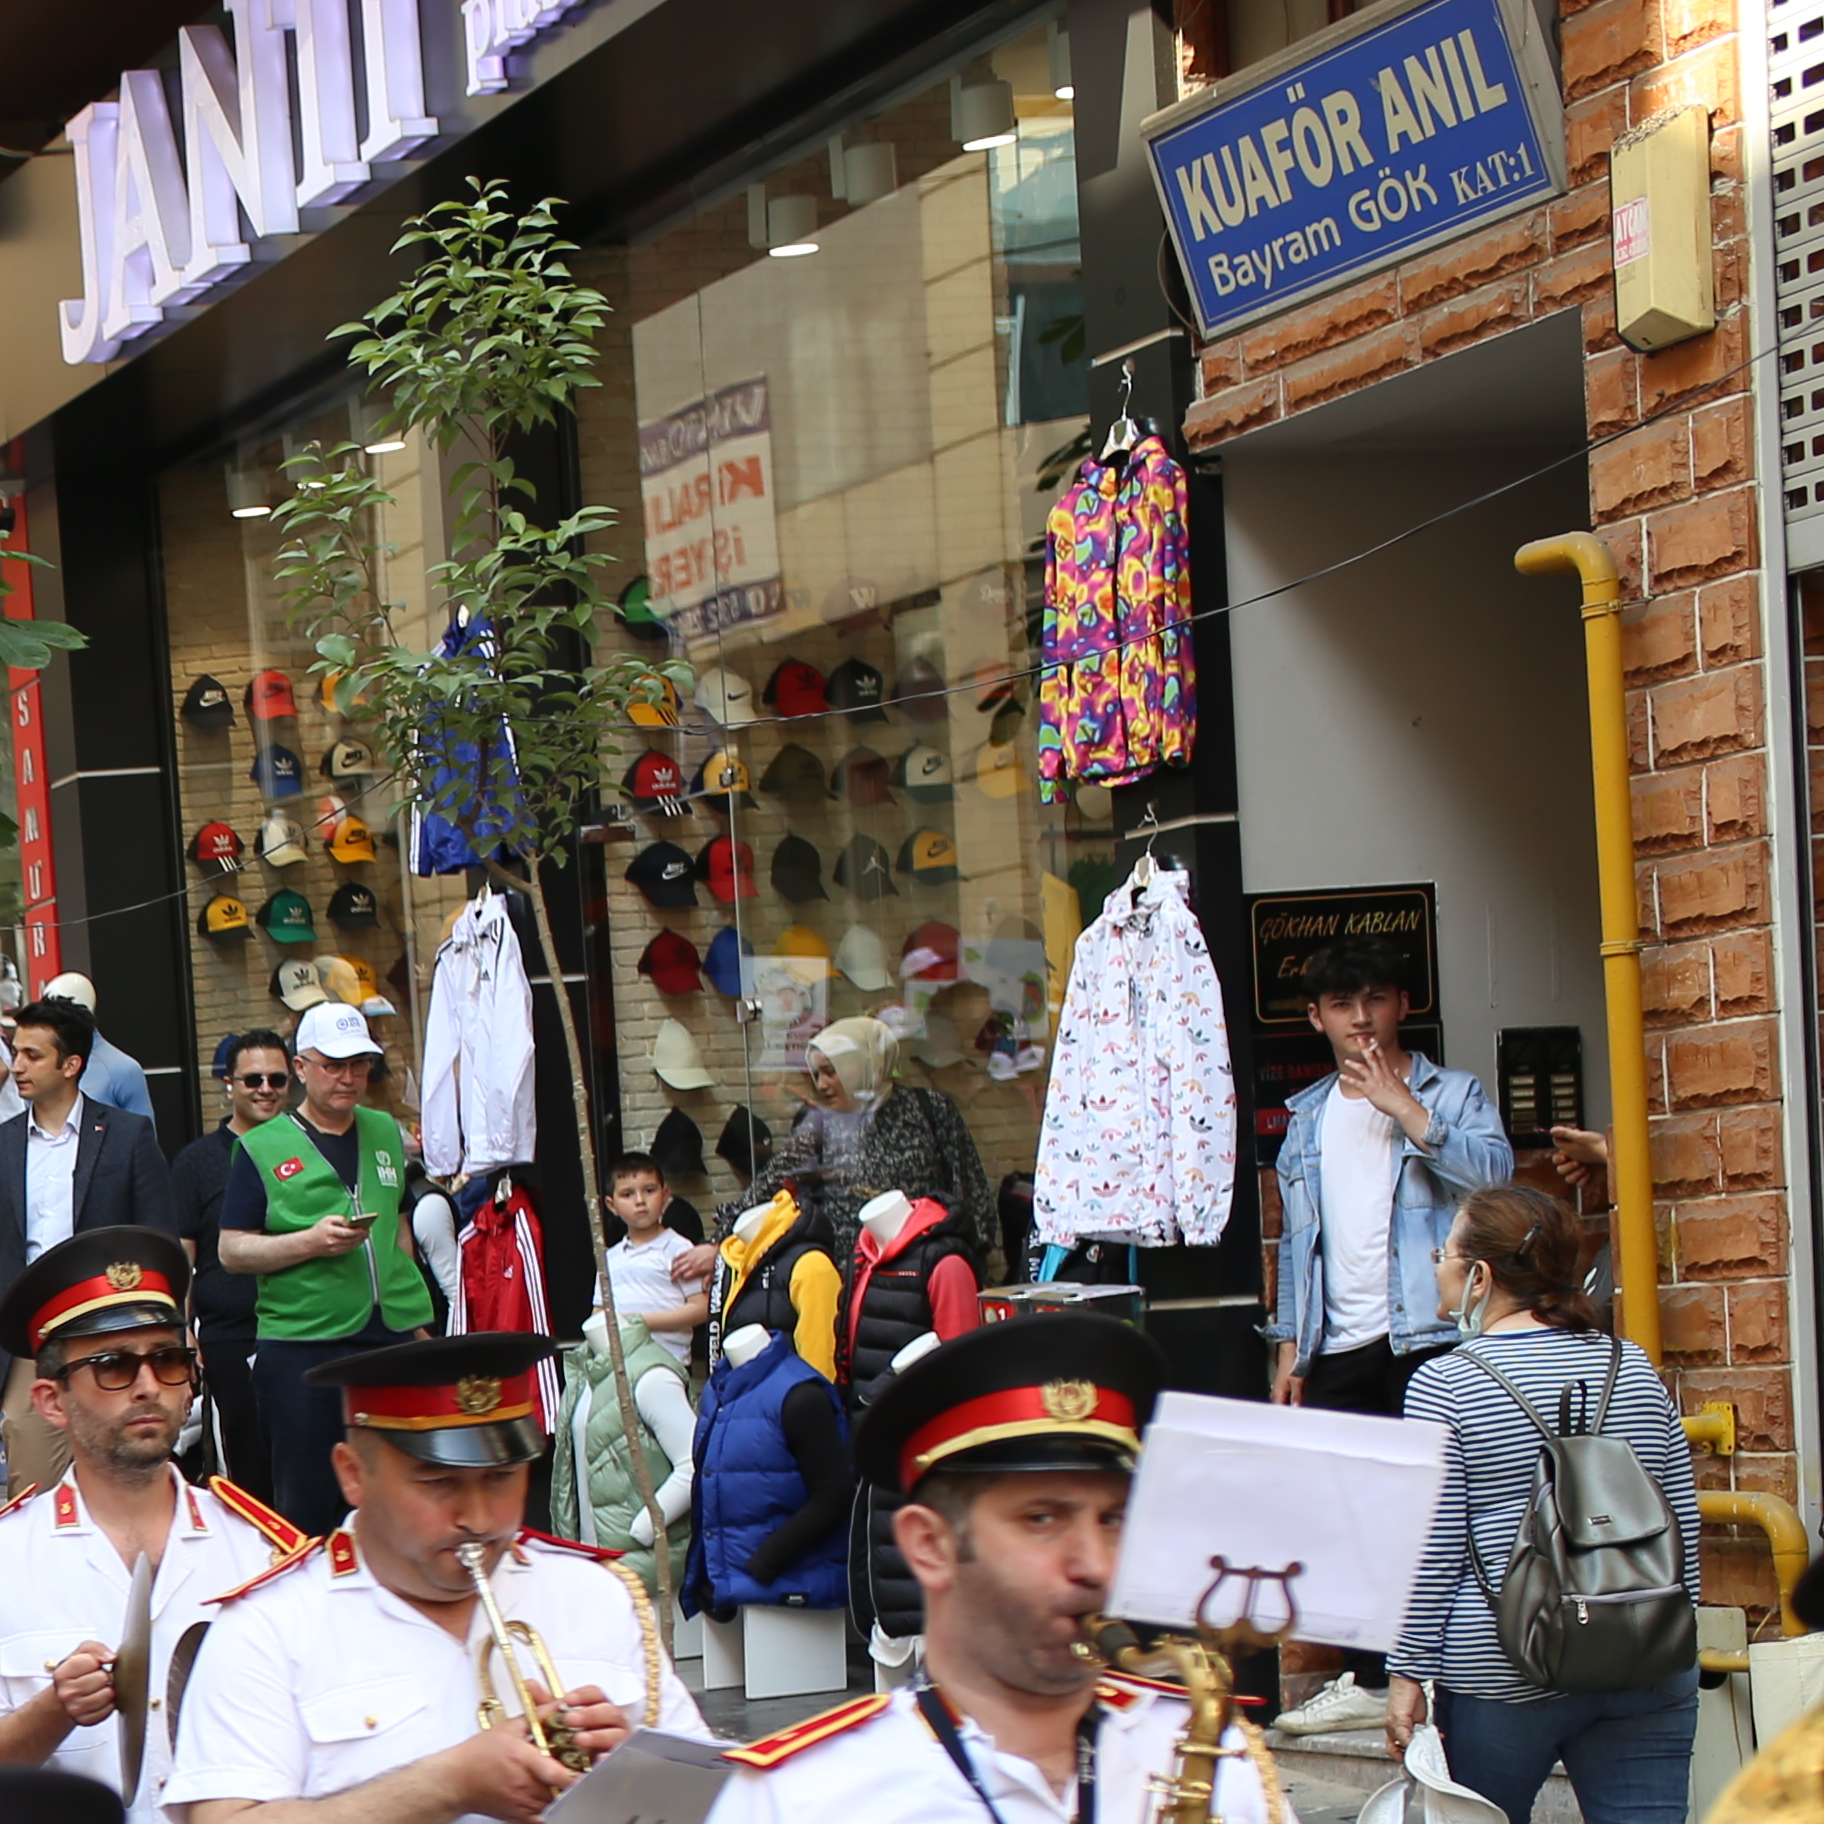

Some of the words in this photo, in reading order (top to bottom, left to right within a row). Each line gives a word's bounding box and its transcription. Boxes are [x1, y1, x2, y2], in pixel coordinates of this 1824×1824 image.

[1175, 84, 1373, 241] KUAFÖR
[1379, 28, 1508, 154] ANIL
[1209, 215, 1342, 297] Bayram
[1348, 166, 1438, 234] GÖK
[1449, 142, 1536, 206] KAT:1
[1344, 908, 1422, 934] KABLAN
